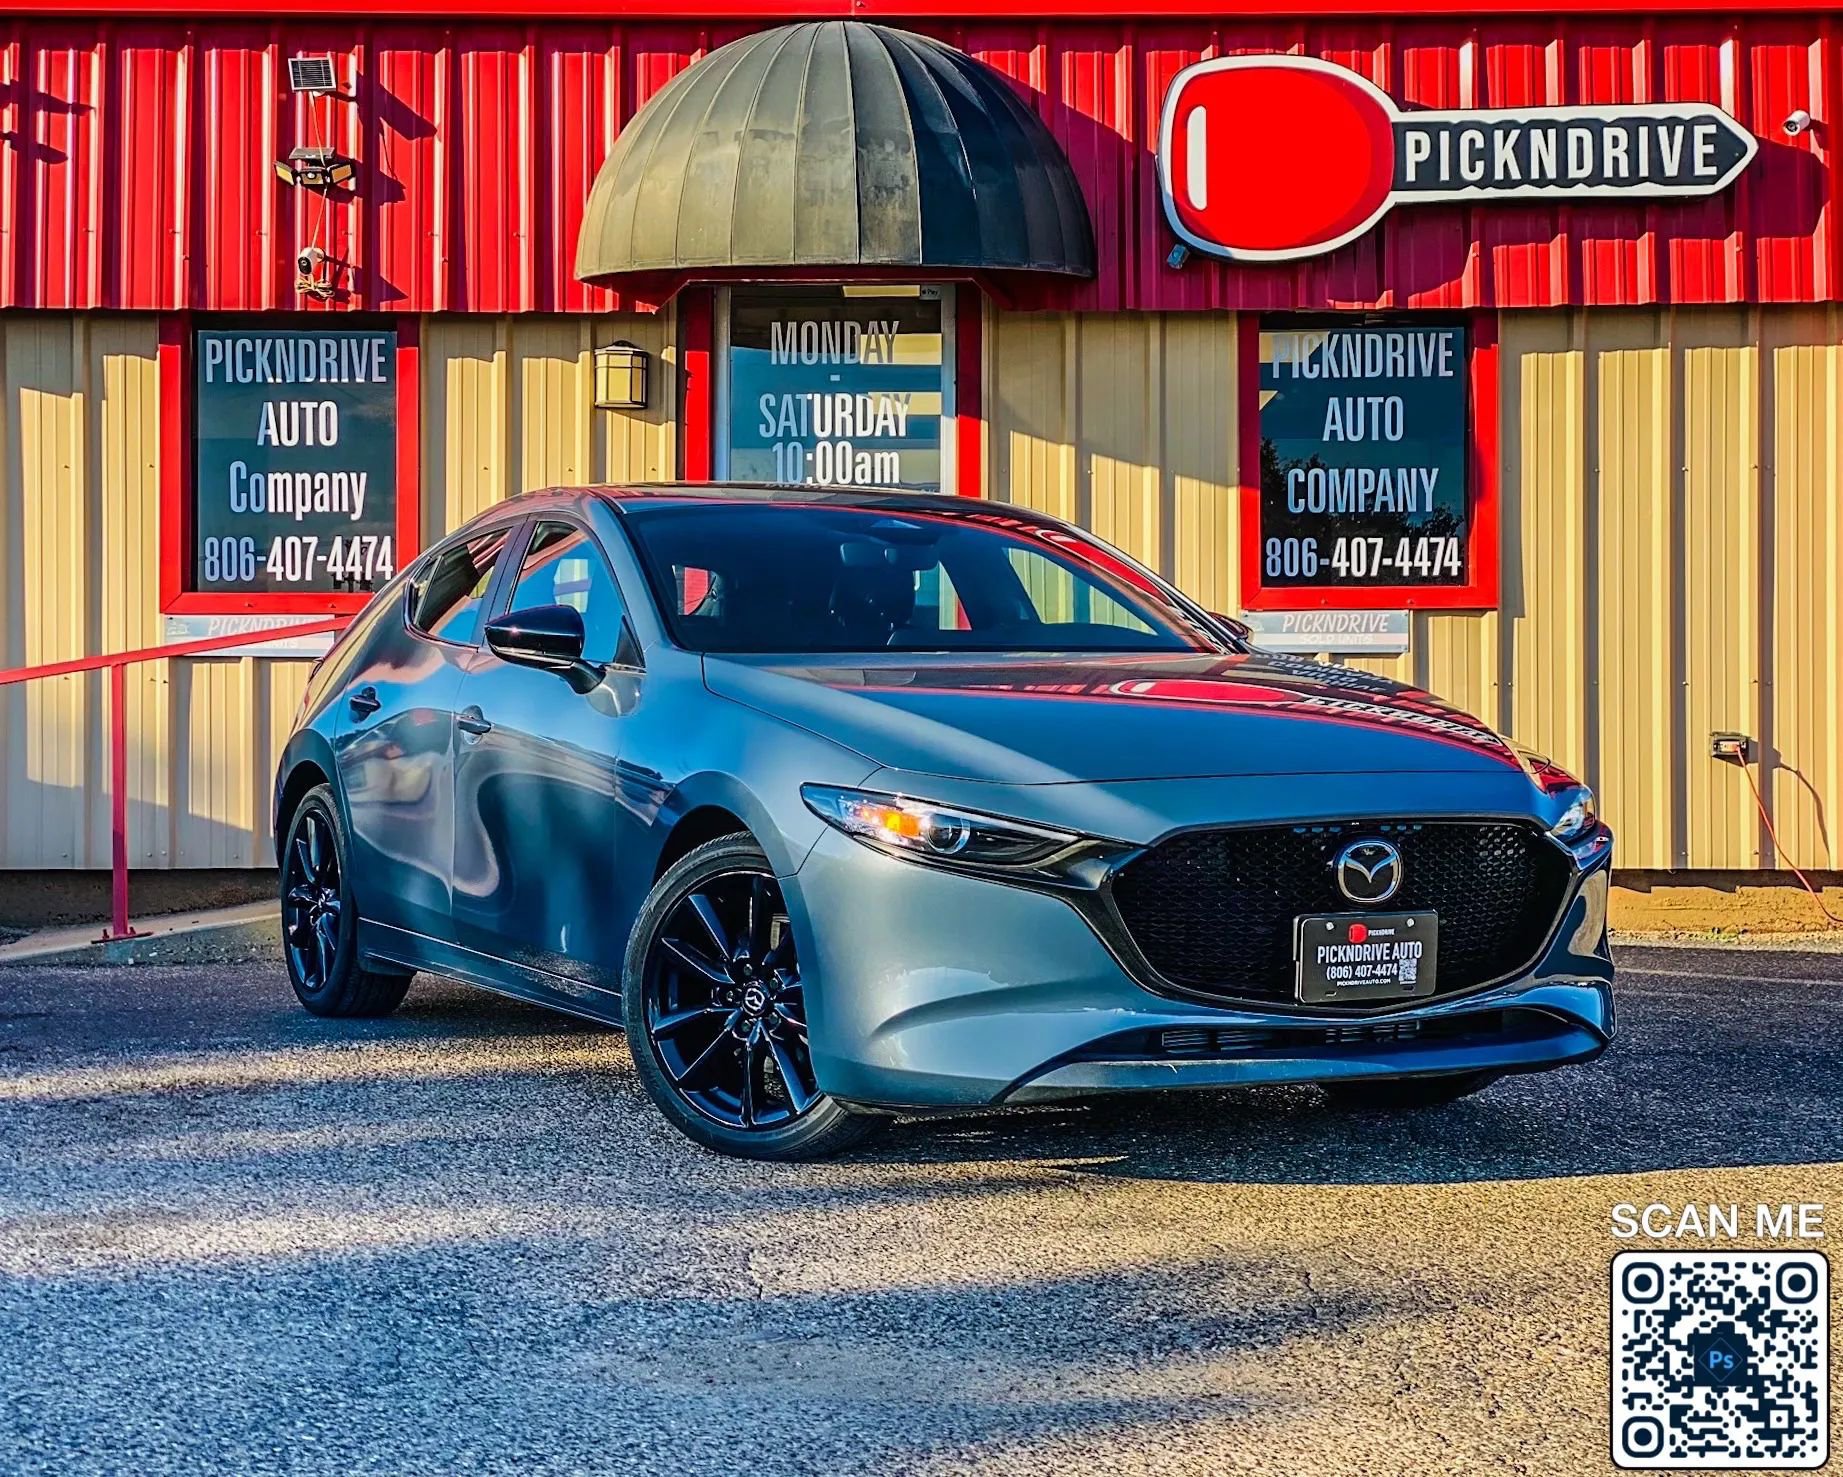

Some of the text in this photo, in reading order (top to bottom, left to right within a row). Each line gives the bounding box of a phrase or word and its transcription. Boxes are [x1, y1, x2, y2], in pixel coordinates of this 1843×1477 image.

[1405, 124, 1717, 182] PICKNDRIVE
[205, 338, 387, 383] PICKNDRIVE
[770, 321, 900, 365] MONDAY
[1272, 332, 1453, 379] PICKNDRIVE
[257, 401, 339, 447] AUTO
[759, 393, 911, 438] SATURDAY
[1322, 396, 1403, 442] AUTO
[771, 441, 900, 485] 10:00am
[229, 460, 367, 521] Company
[1287, 468, 1439, 513] COMPANY
[204, 536, 394, 582] 806-407-4474
[1265, 537, 1462, 577] 806-407-4474
[1282, 613, 1390, 633] PICKNDRIVE
[1317, 941, 1422, 964] PICKNDRIVE AUTO
[1326, 963, 1398, 980] (806) 407-4474
[1336, 978, 1391, 987] PICKNDRIVEAUTO.COM
